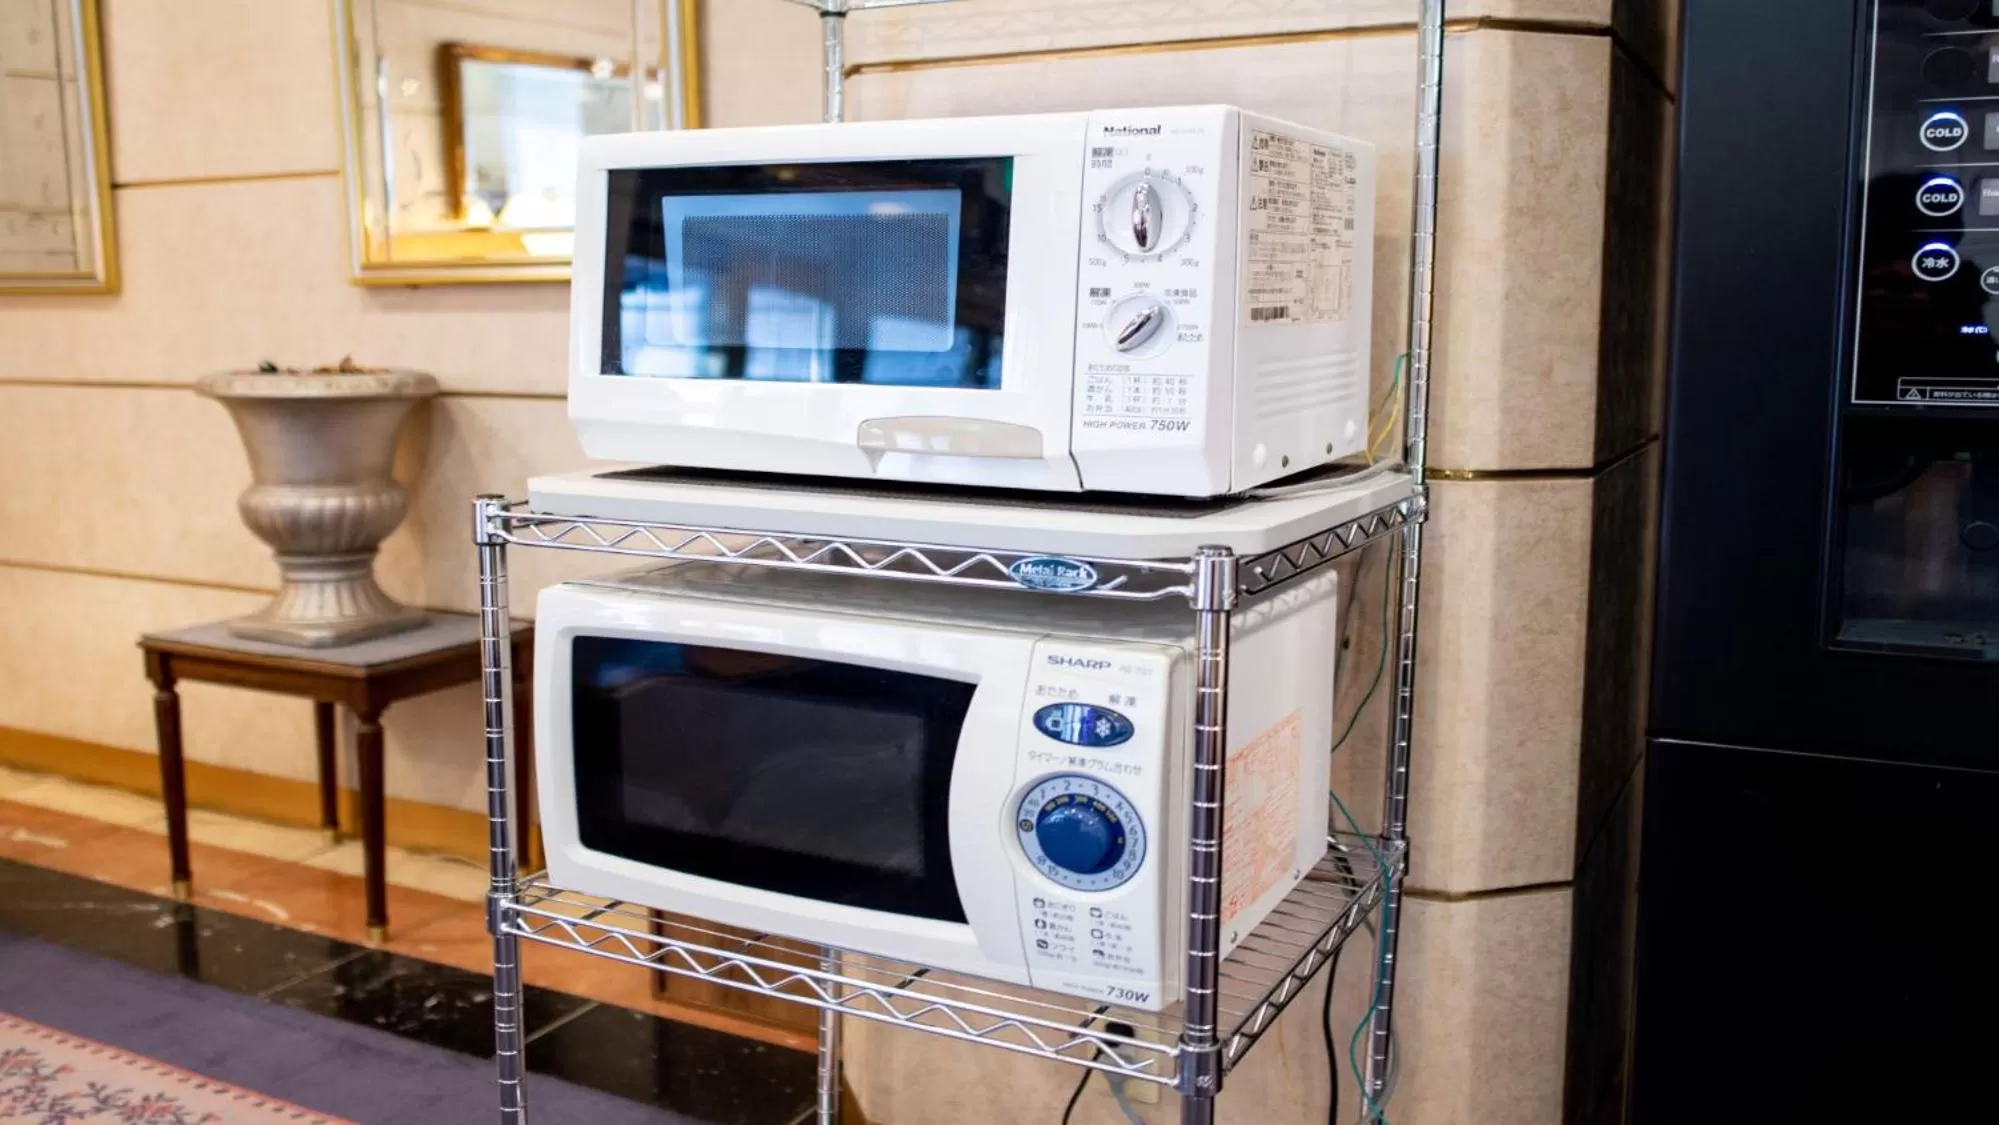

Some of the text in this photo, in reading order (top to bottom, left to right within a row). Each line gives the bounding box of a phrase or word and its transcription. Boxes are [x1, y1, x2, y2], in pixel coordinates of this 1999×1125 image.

[1103, 124, 1161, 136] National
[1926, 126, 1963, 138] COLD
[1922, 193, 1958, 203] COLD
[1922, 257, 1950, 269] 冷水
[1083, 419, 1191, 432] HIGH POWER 750W
[1057, 565, 1088, 579] Rack
[1047, 654, 1112, 670] SHARP
[1063, 779, 1071, 792] 2
[1105, 985, 1150, 1003] 730W
